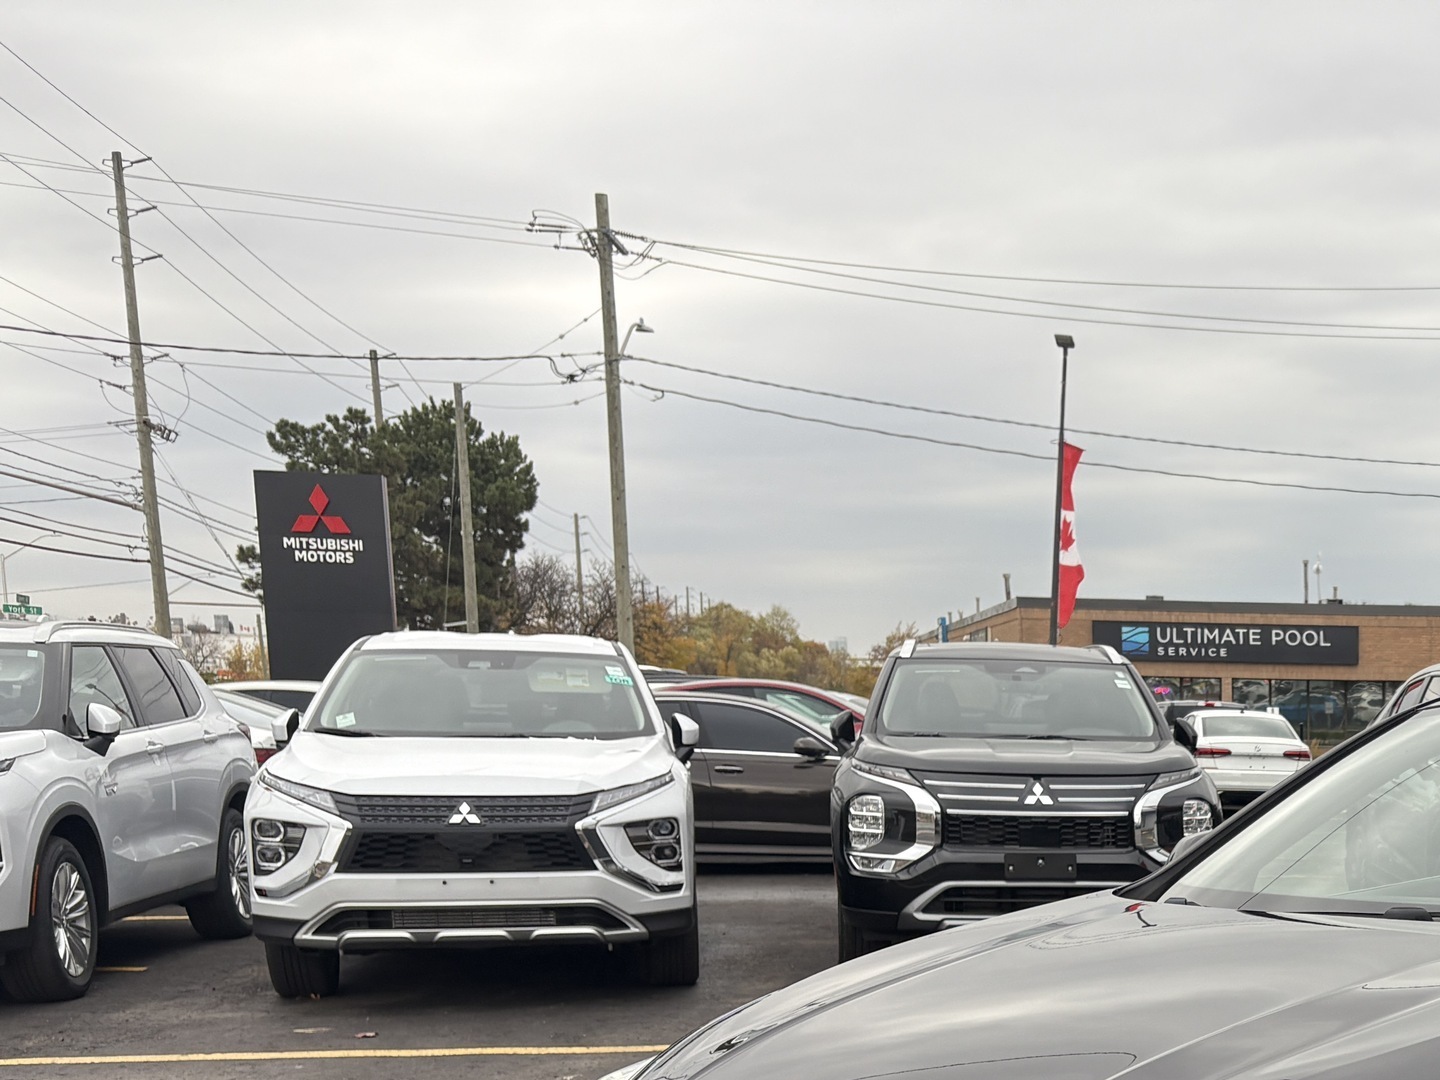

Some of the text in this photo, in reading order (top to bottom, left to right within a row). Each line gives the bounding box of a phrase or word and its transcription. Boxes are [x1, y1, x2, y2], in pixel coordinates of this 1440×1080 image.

[282, 536, 364, 552] MITSUBISHI
[294, 549, 355, 564] MOTORS
[1155, 626, 1332, 647] ULTIMATE POOL
[1156, 646, 1229, 657] SERVICE
